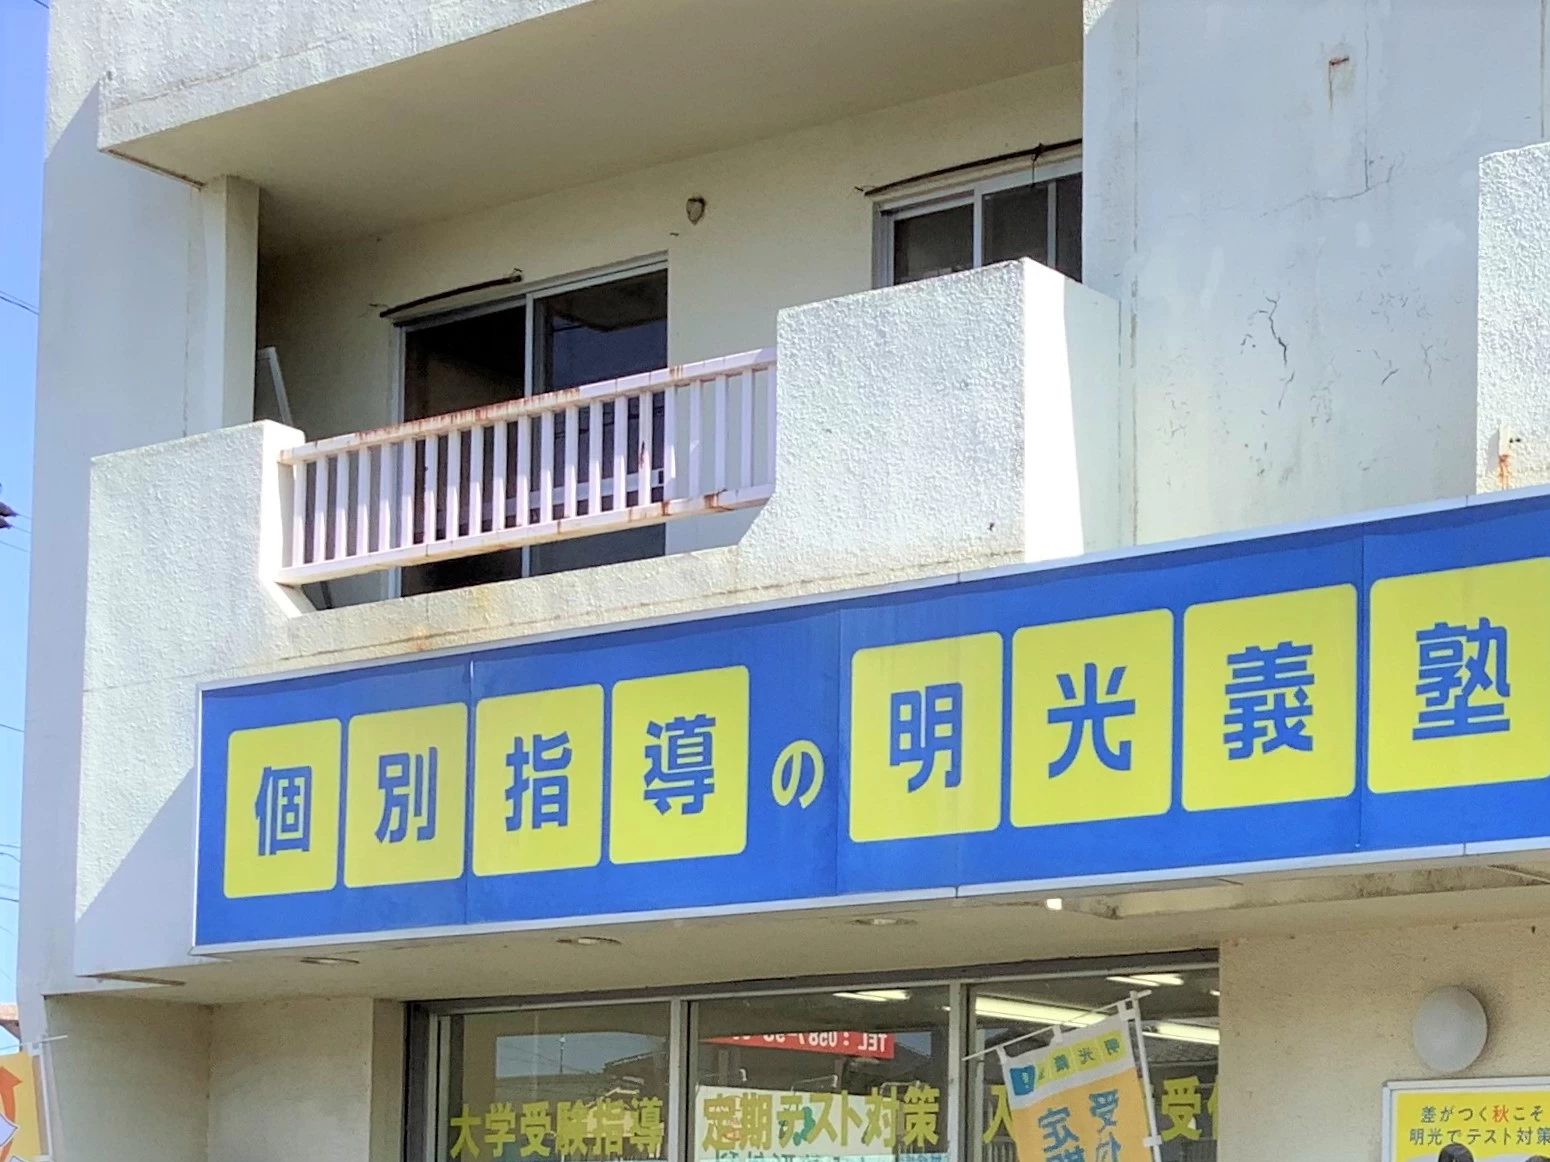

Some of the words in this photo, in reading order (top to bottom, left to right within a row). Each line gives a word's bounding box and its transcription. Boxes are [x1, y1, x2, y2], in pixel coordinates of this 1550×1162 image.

[450, 1096, 664, 1160] 大学受験指導
[702, 1083, 941, 1152] 定期テスト対策
[1421, 1104, 1543, 1124] 差がつく秋こそ
